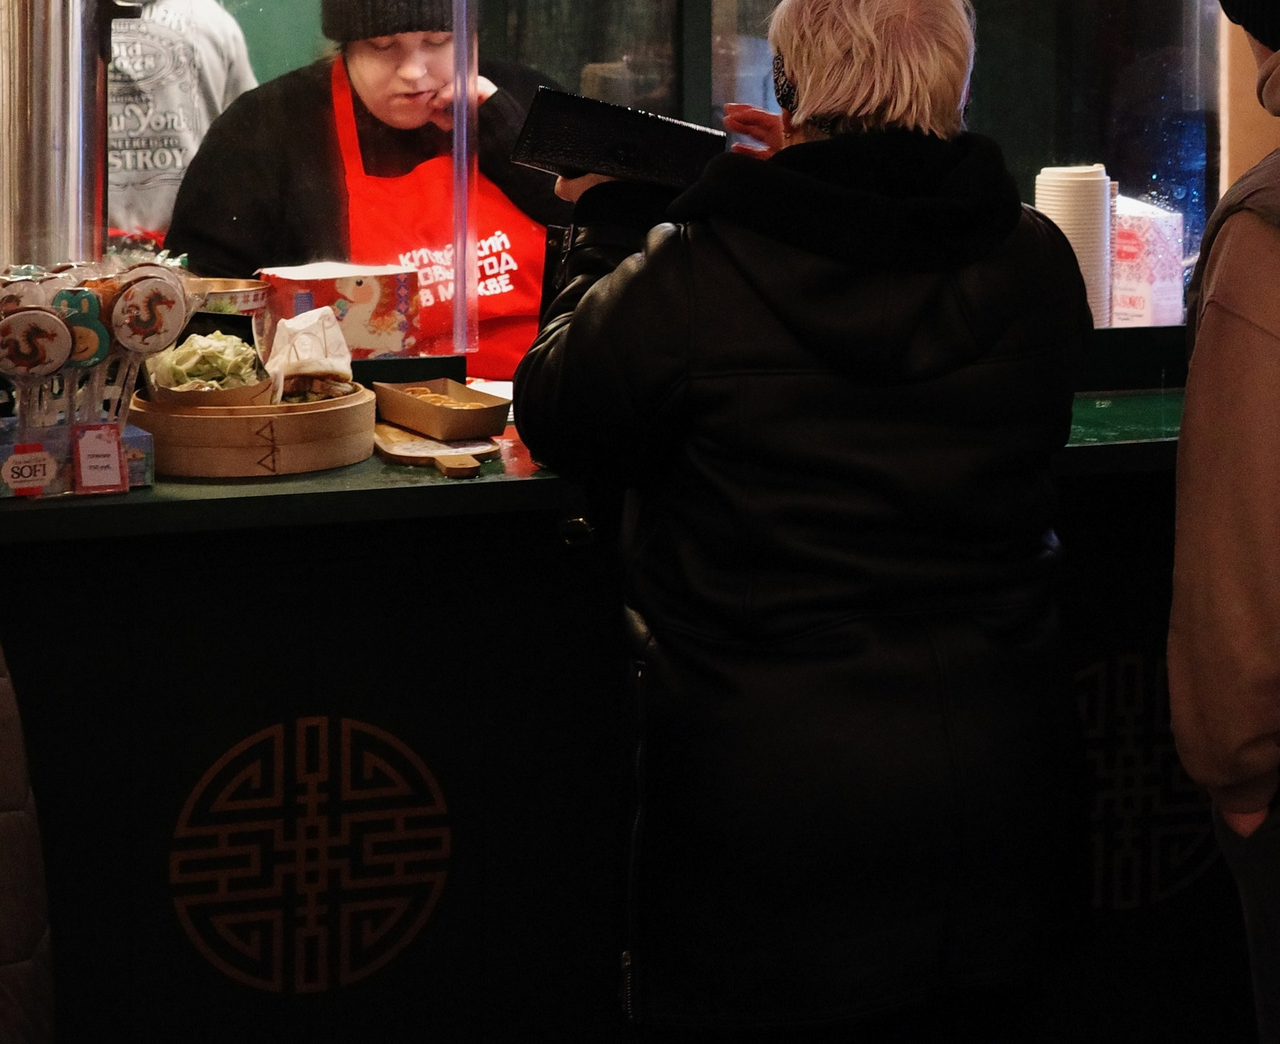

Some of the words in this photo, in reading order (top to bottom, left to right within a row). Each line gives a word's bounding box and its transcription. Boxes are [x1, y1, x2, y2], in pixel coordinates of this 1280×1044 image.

[419, 287, 435, 308] В
[437, 273, 515, 303] МКВЕ
[11, 463, 47, 480] SOFI
